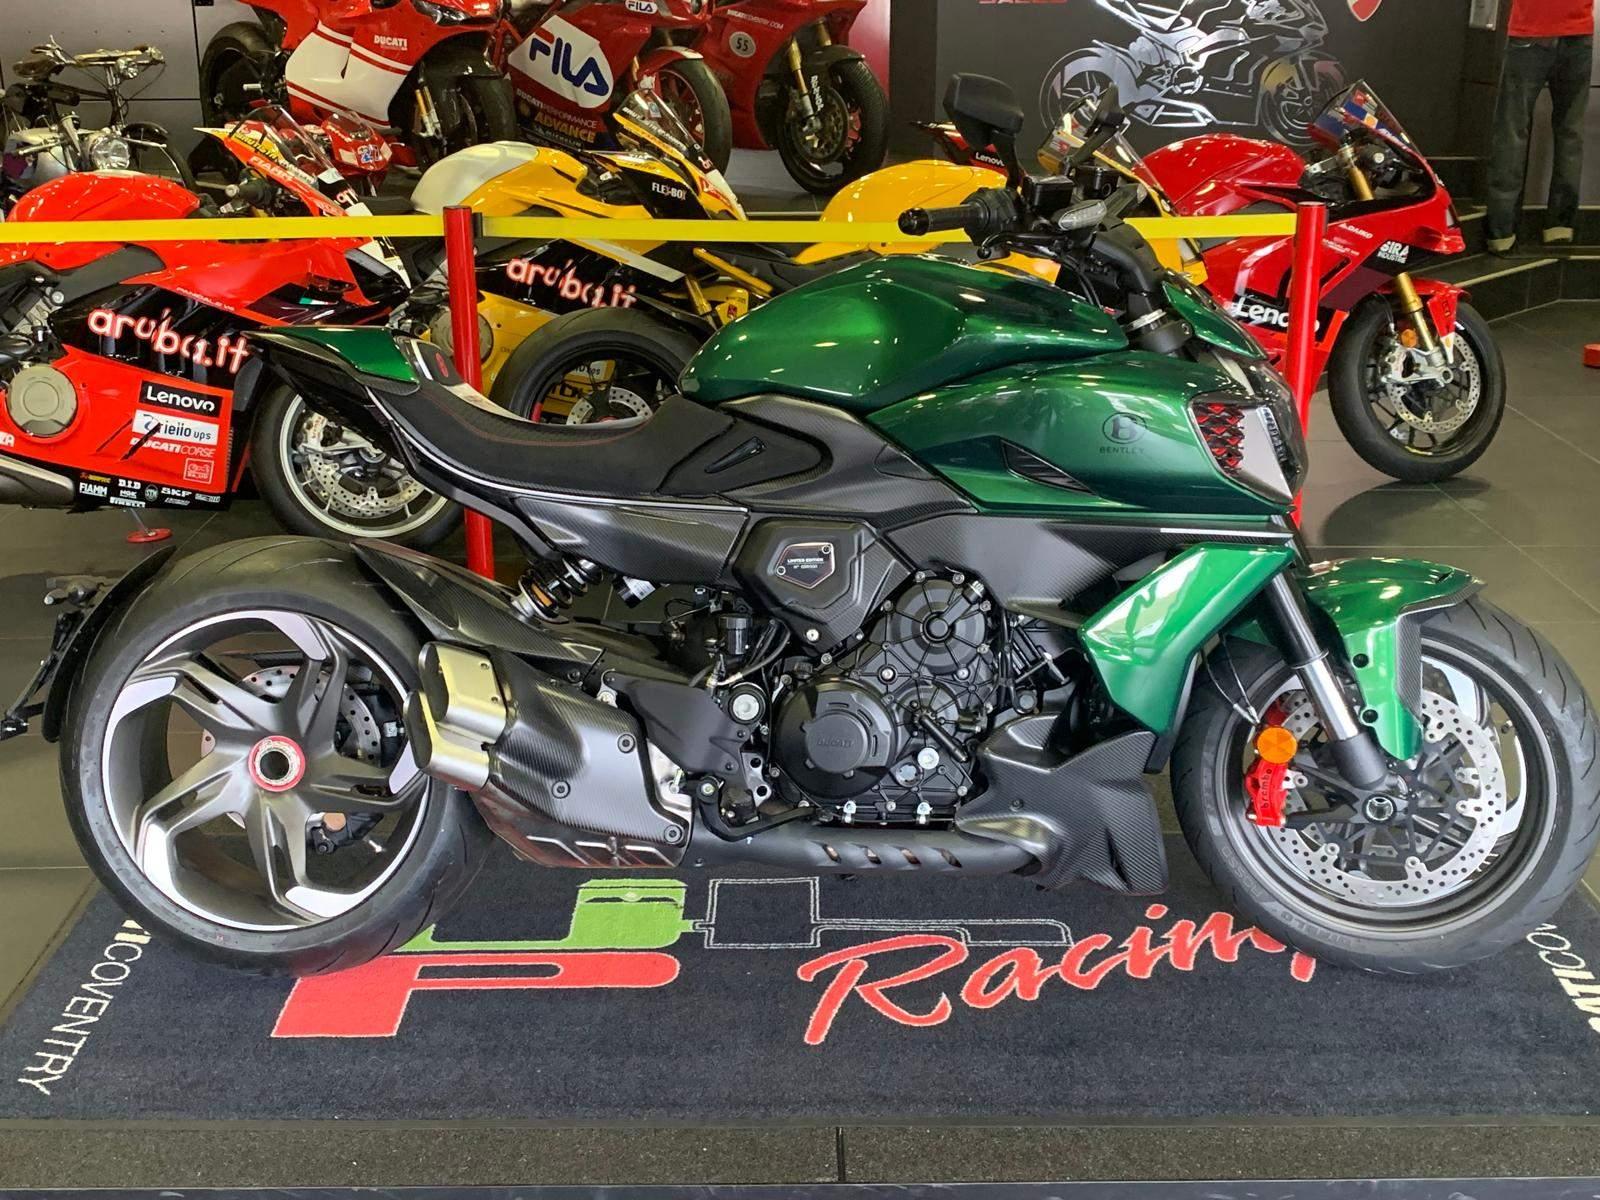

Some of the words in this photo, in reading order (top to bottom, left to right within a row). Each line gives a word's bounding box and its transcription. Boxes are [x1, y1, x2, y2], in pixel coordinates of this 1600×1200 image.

[628, 1, 653, 13] FILA
[373, 34, 408, 48] DUCATI
[736, 37, 749, 52] 55
[528, 26, 610, 97] FILA
[534, 111, 598, 143] ADVANCE
[975, 152, 1005, 167] Lenov
[88, 308, 250, 374] aruba.it
[146, 385, 215, 412] Lenovo
[1099, 446, 1145, 455] BENTLEY
[79, 482, 108, 497] FIAMM
